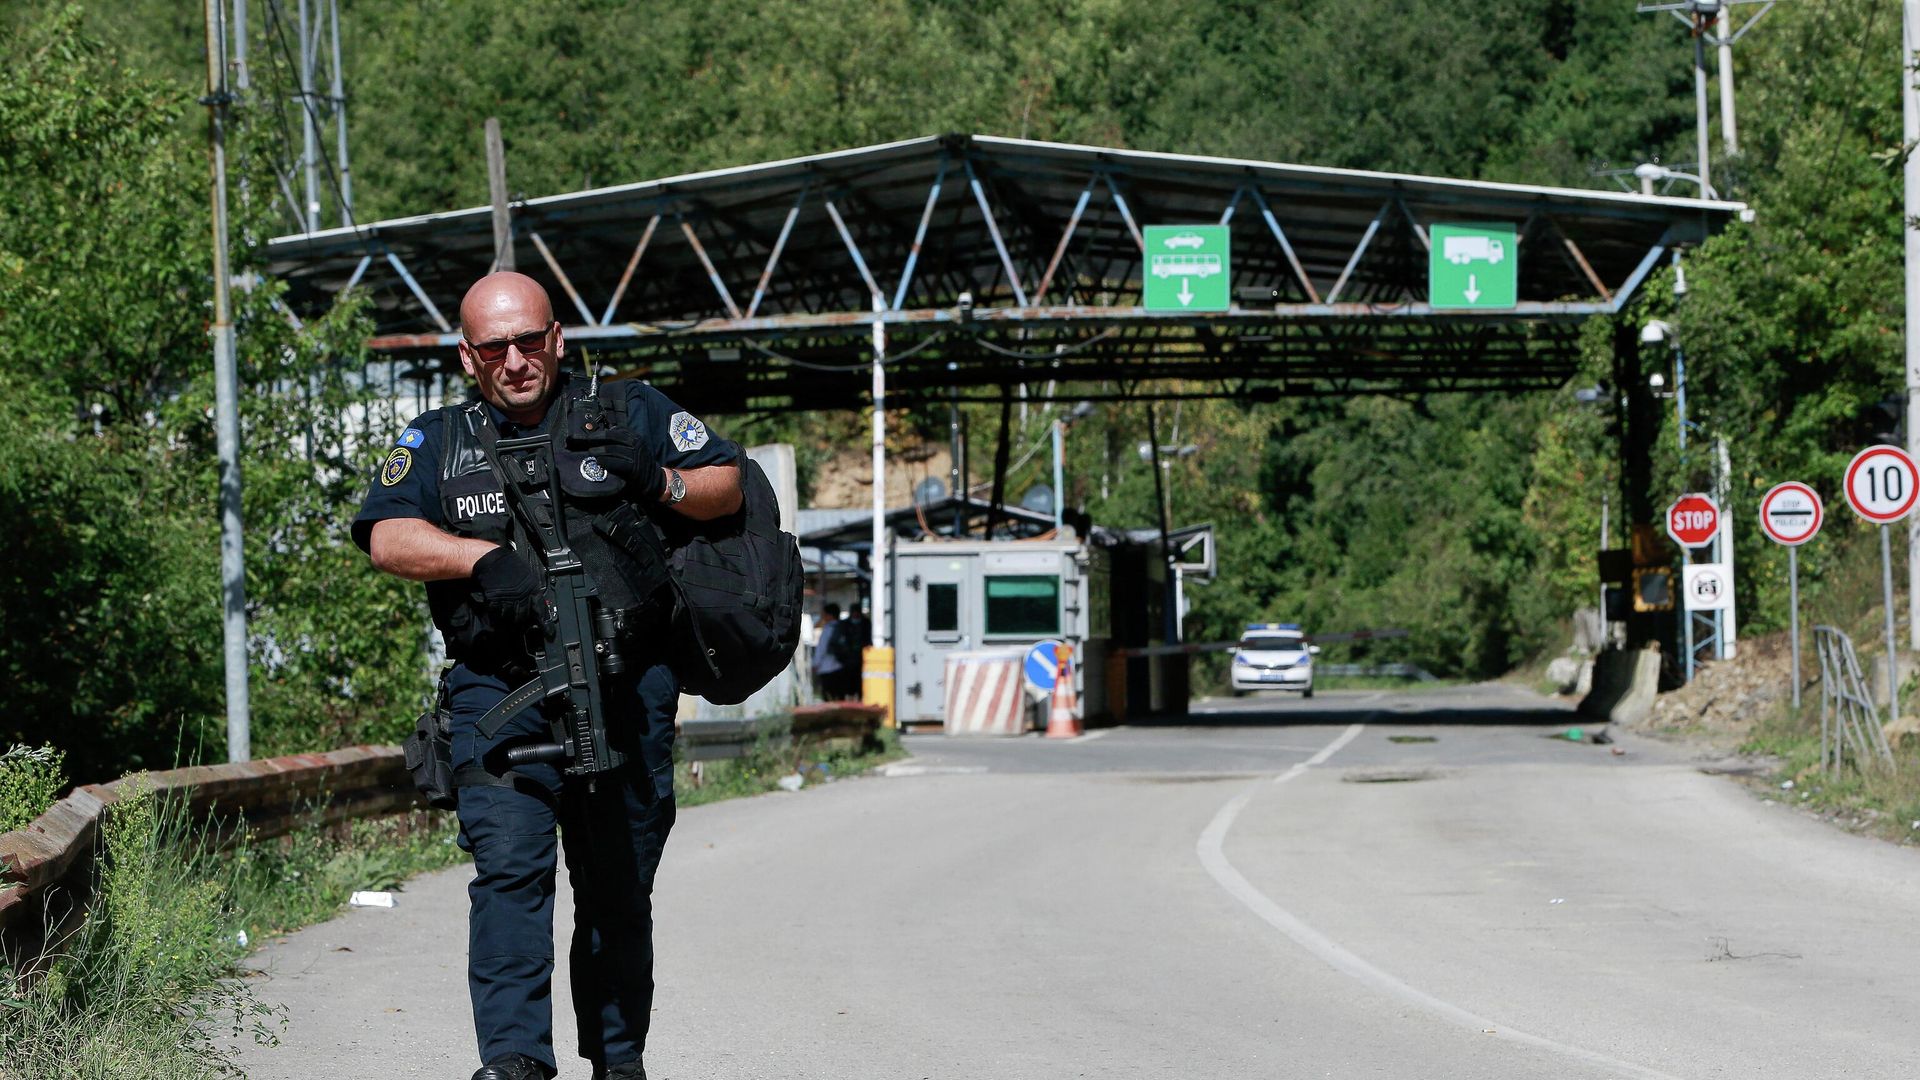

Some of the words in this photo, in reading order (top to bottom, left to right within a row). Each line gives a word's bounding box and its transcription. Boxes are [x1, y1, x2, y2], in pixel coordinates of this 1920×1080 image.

[1867, 465, 1902, 502] 10
[456, 492, 505, 519] POLICE
[1673, 510, 1714, 531] STOP
